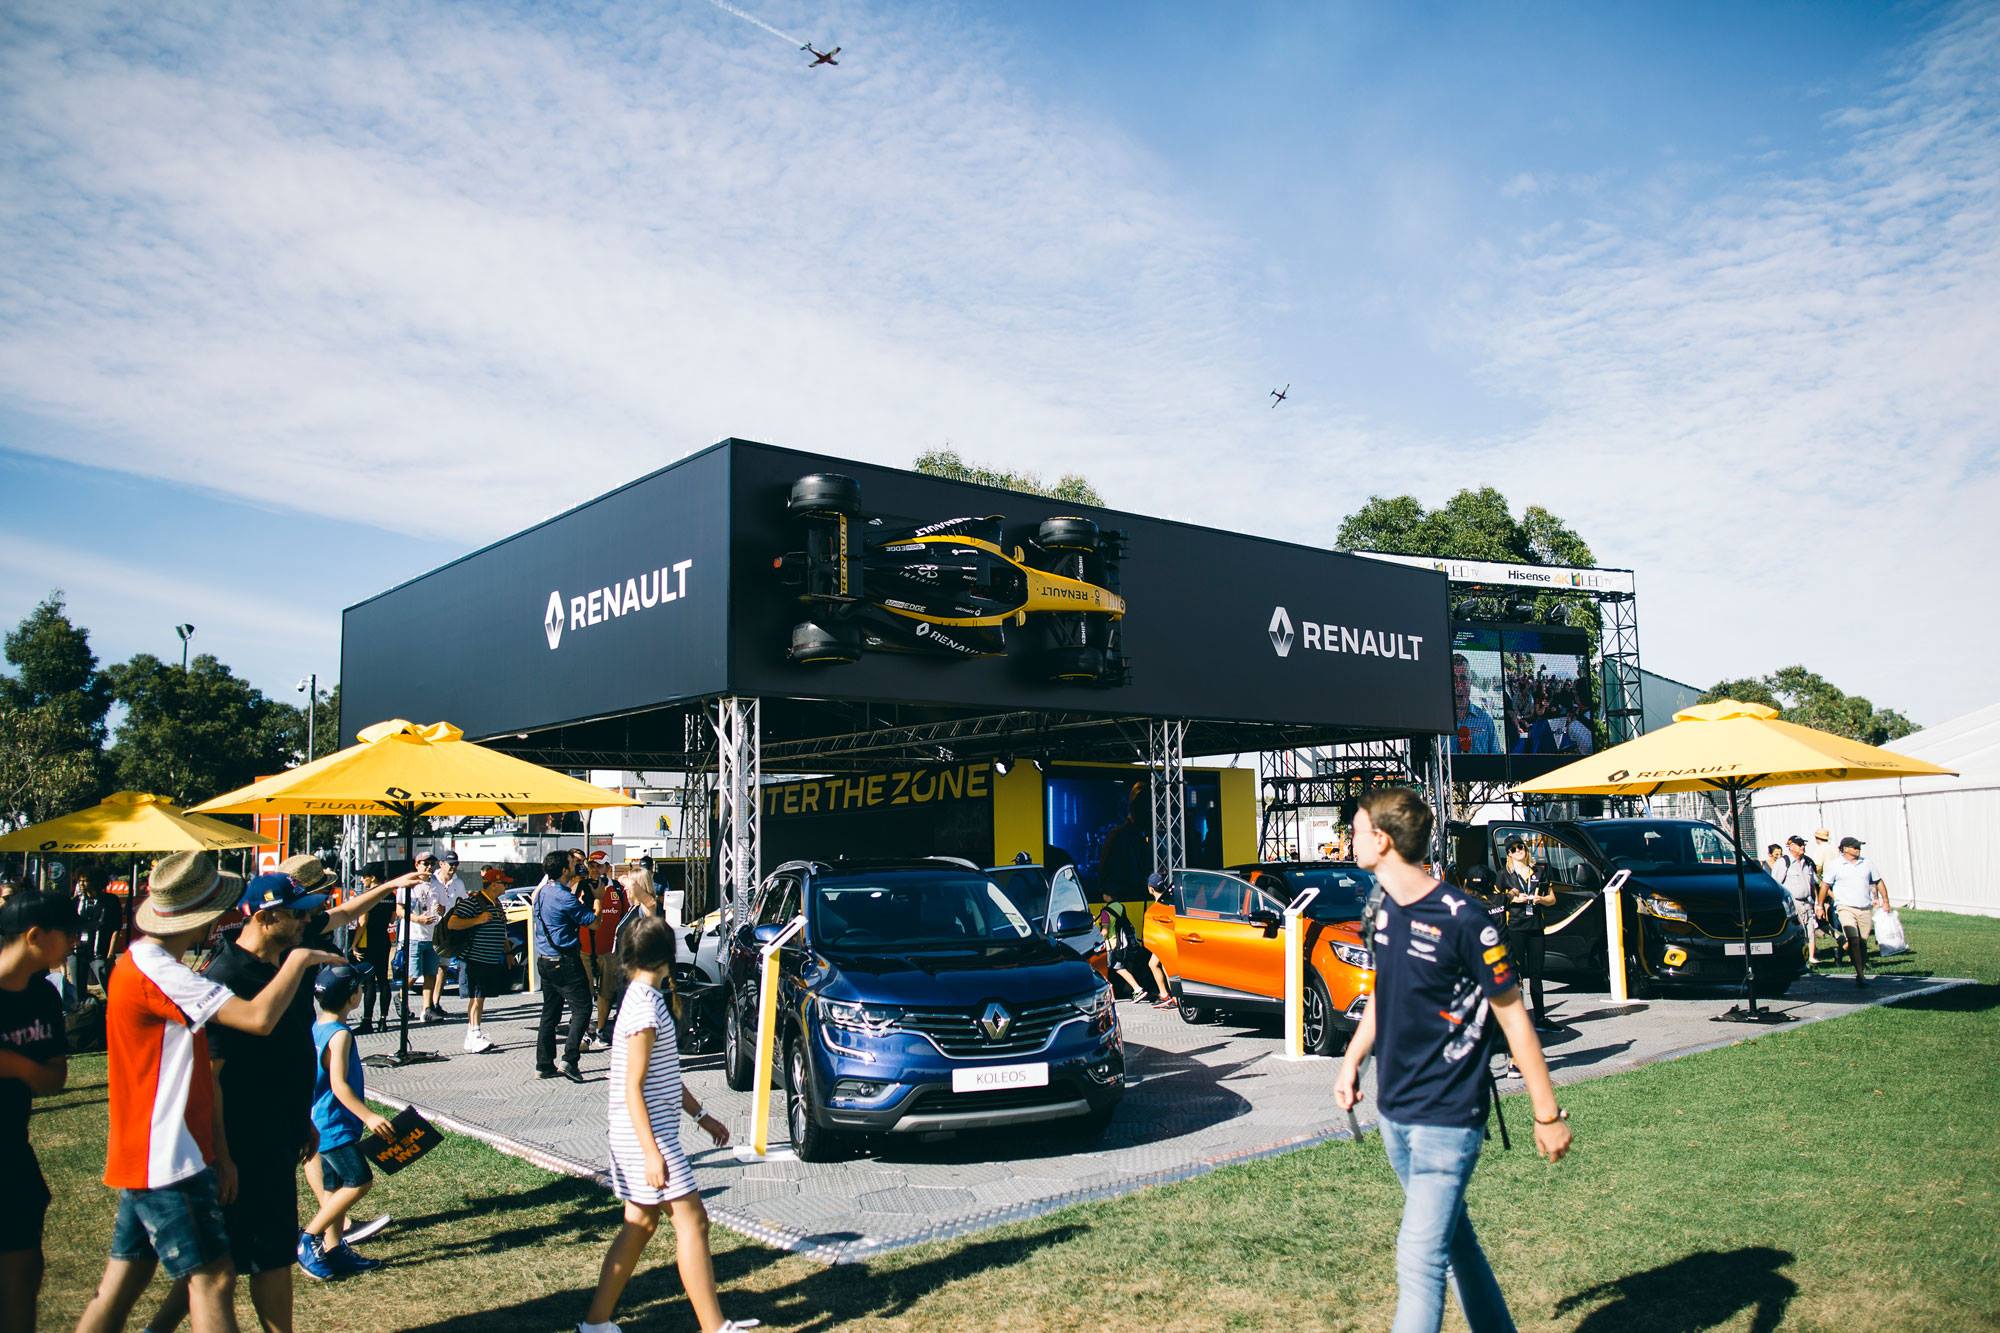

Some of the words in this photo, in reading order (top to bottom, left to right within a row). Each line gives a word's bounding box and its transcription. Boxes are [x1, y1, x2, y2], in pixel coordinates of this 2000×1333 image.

[1508, 569, 1551, 583] Hisense
[570, 558, 693, 631] RENAULT
[1041, 586, 1088, 601] RENAULT
[904, 602, 926, 613] EDGE
[1302, 621, 1423, 661] RENAULT
[1636, 763, 1742, 779] RENAULT
[420, 791, 513, 799] RENAULT
[760, 785, 820, 816] TER
[825, 775, 886, 811] THE
[890, 762, 991, 805] ZONE
[62, 842, 139, 850] RENAULT
[976, 1070, 1027, 1086] KOLEOS
